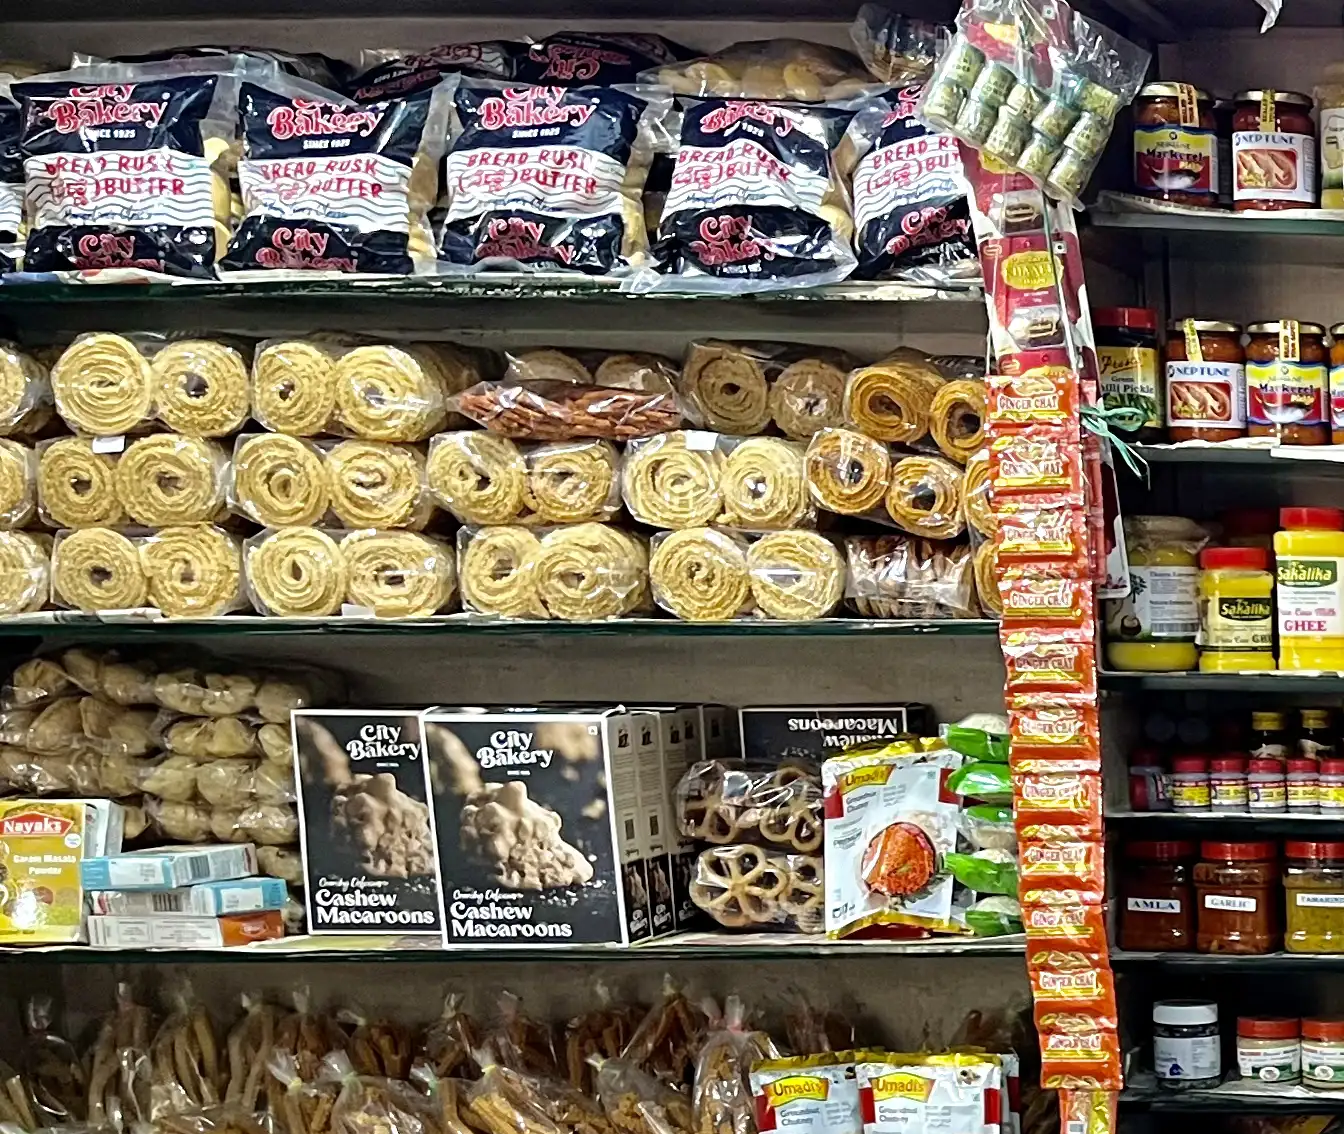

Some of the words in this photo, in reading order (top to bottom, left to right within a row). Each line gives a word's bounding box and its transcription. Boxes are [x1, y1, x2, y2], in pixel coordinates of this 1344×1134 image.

[50, 100, 168, 134] Bakery
[267, 106, 384, 139] Bakery
[477, 97, 596, 130] Bakery
[1242, 133, 1296, 146] NEPTUNE
[467, 152, 529, 167] BREAD
[678, 146, 735, 163] BREAD
[872, 141, 928, 170] BREAD
[325, 158, 378, 175] RUSK
[520, 168, 598, 194] BUTTER
[700, 214, 752, 243] City
[901, 206, 949, 236] City
[79, 234, 135, 258] City
[272, 227, 330, 256] City
[1176, 366, 1229, 377] NEPTUNE
[1000, 396, 1031, 410] GINGER
[1034, 395, 1058, 409] CHAT
[1277, 566, 1332, 582] Sakalika
[1012, 593, 1045, 607] GINGER
[1047, 593, 1072, 607] CHAT
[1221, 602, 1270, 617] Sakalika
[1284, 620, 1327, 632] GHEE
[1016, 656, 1049, 670] GINGER
[1051, 655, 1074, 669] CHAT
[360, 724, 402, 743] City
[788, 717, 898, 735] Macaroons
[490, 730, 534, 750] City
[346, 739, 421, 762] Bakery
[476, 747, 554, 770] Bakery
[43, 854, 77, 865] Masala
[1029, 847, 1061, 863] GINGER
[315, 889, 398, 908] Cashew
[1132, 900, 1176, 911] AMLA
[1210, 897, 1251, 909] GARLIC
[317, 907, 435, 925] Macaroons
[450, 901, 533, 921] Cashew
[451, 920, 573, 939] Macaroons
[1042, 974, 1073, 988] GINGER
